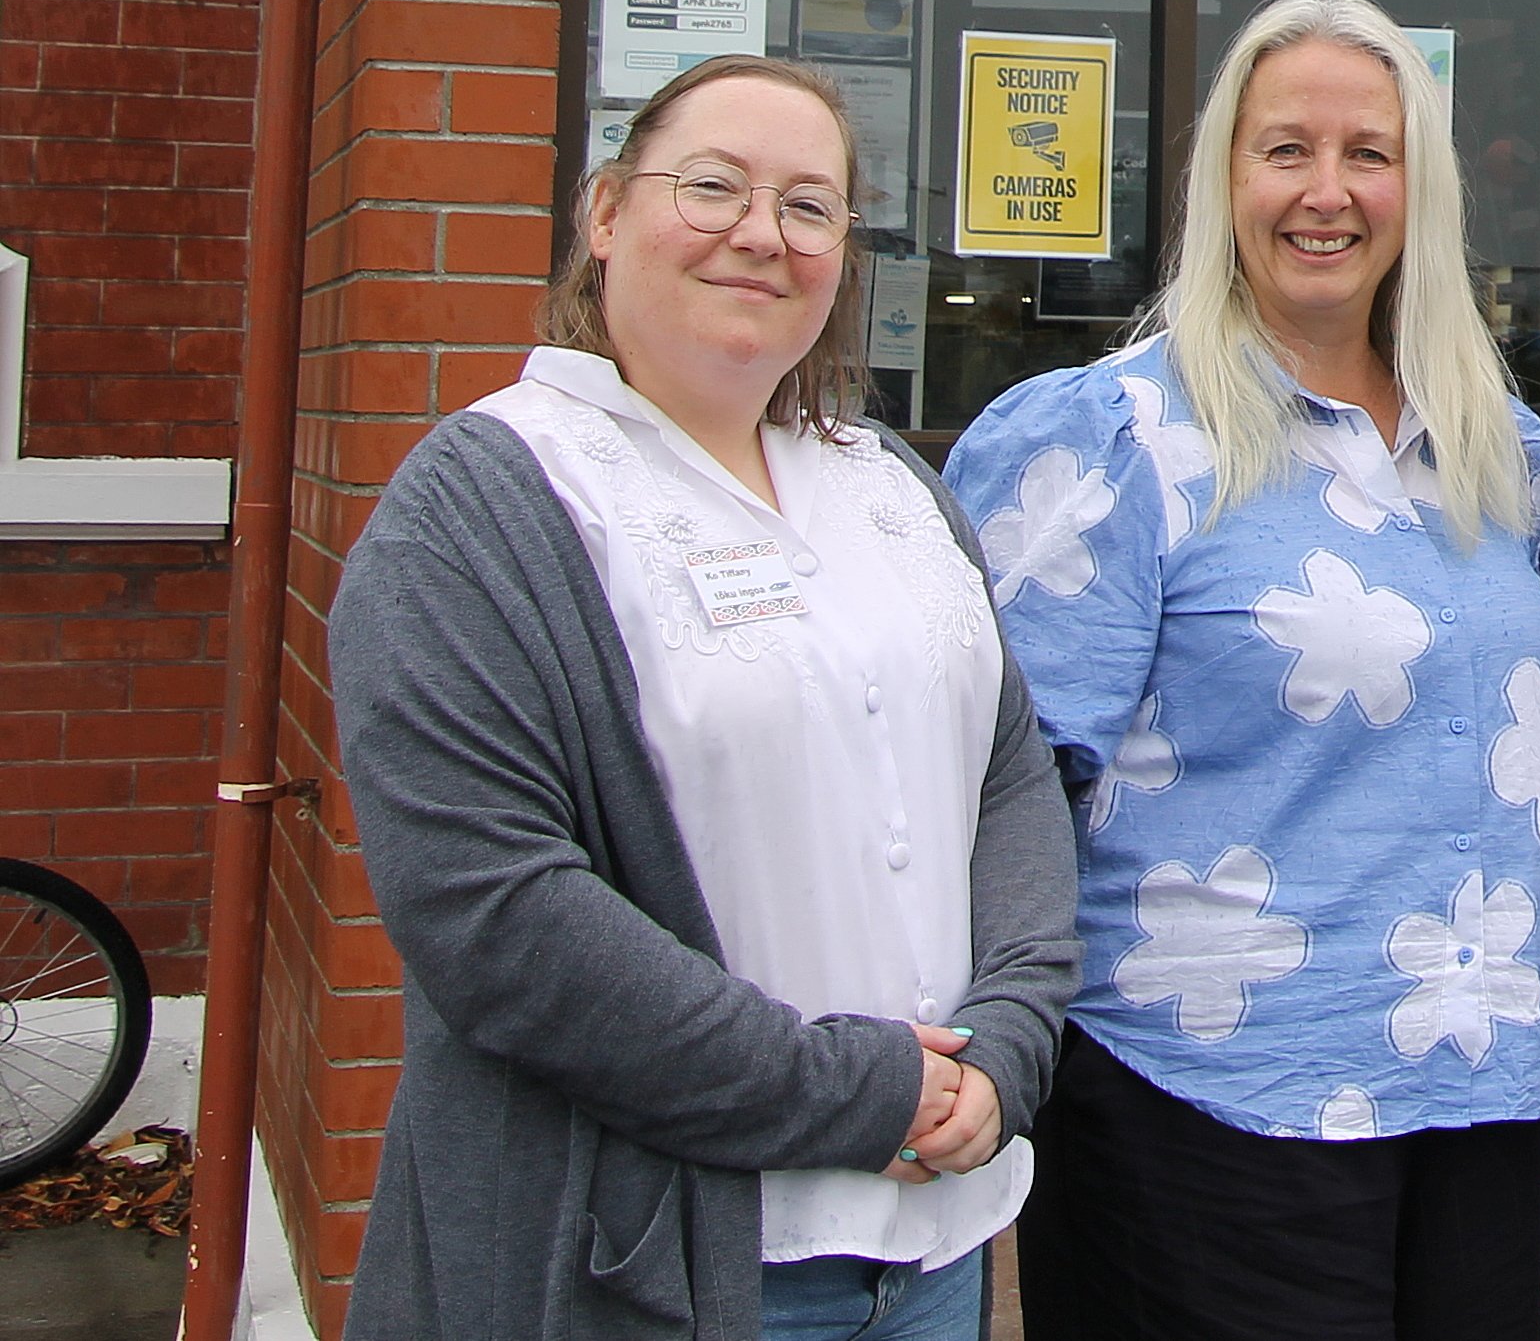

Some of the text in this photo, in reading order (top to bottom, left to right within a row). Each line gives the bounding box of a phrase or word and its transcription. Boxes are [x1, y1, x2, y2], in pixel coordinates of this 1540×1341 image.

[709, 0, 741, 10] Library
[997, 67, 1080, 91] SECURITY
[1007, 92, 1068, 115] NOTICE
[993, 175, 1077, 198] CAMERAS
[1007, 201, 1063, 222] IN USE
